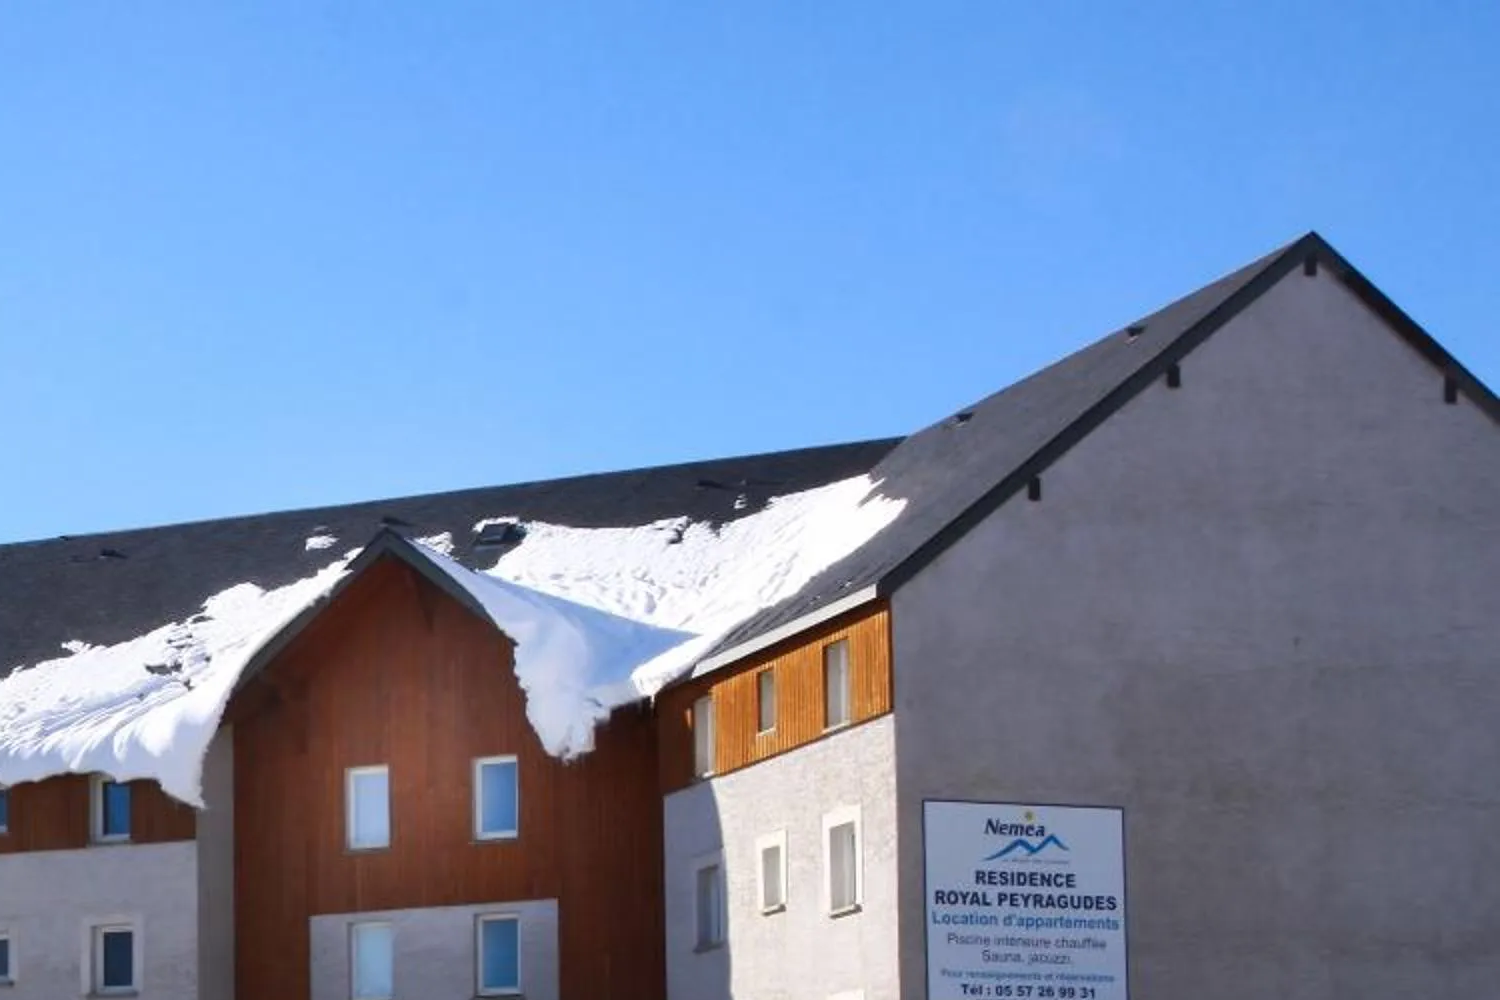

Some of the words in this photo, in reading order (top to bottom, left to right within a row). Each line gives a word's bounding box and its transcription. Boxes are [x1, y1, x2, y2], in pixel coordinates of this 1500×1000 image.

[975, 870, 1076, 888] RESIDENCE
[934, 890, 992, 906] ROYAL
[997, 892, 1117, 910] PEYRAGUDES
[932, 911, 998, 926] Location
[1003, 913, 1120, 931] d'appartements
[947, 932, 991, 947] Piscine
[995, 985, 1013, 997] 05
[1016, 985, 1034, 997] 57
[1037, 986, 1055, 998] 26
[1079, 987, 1097, 999] 31
